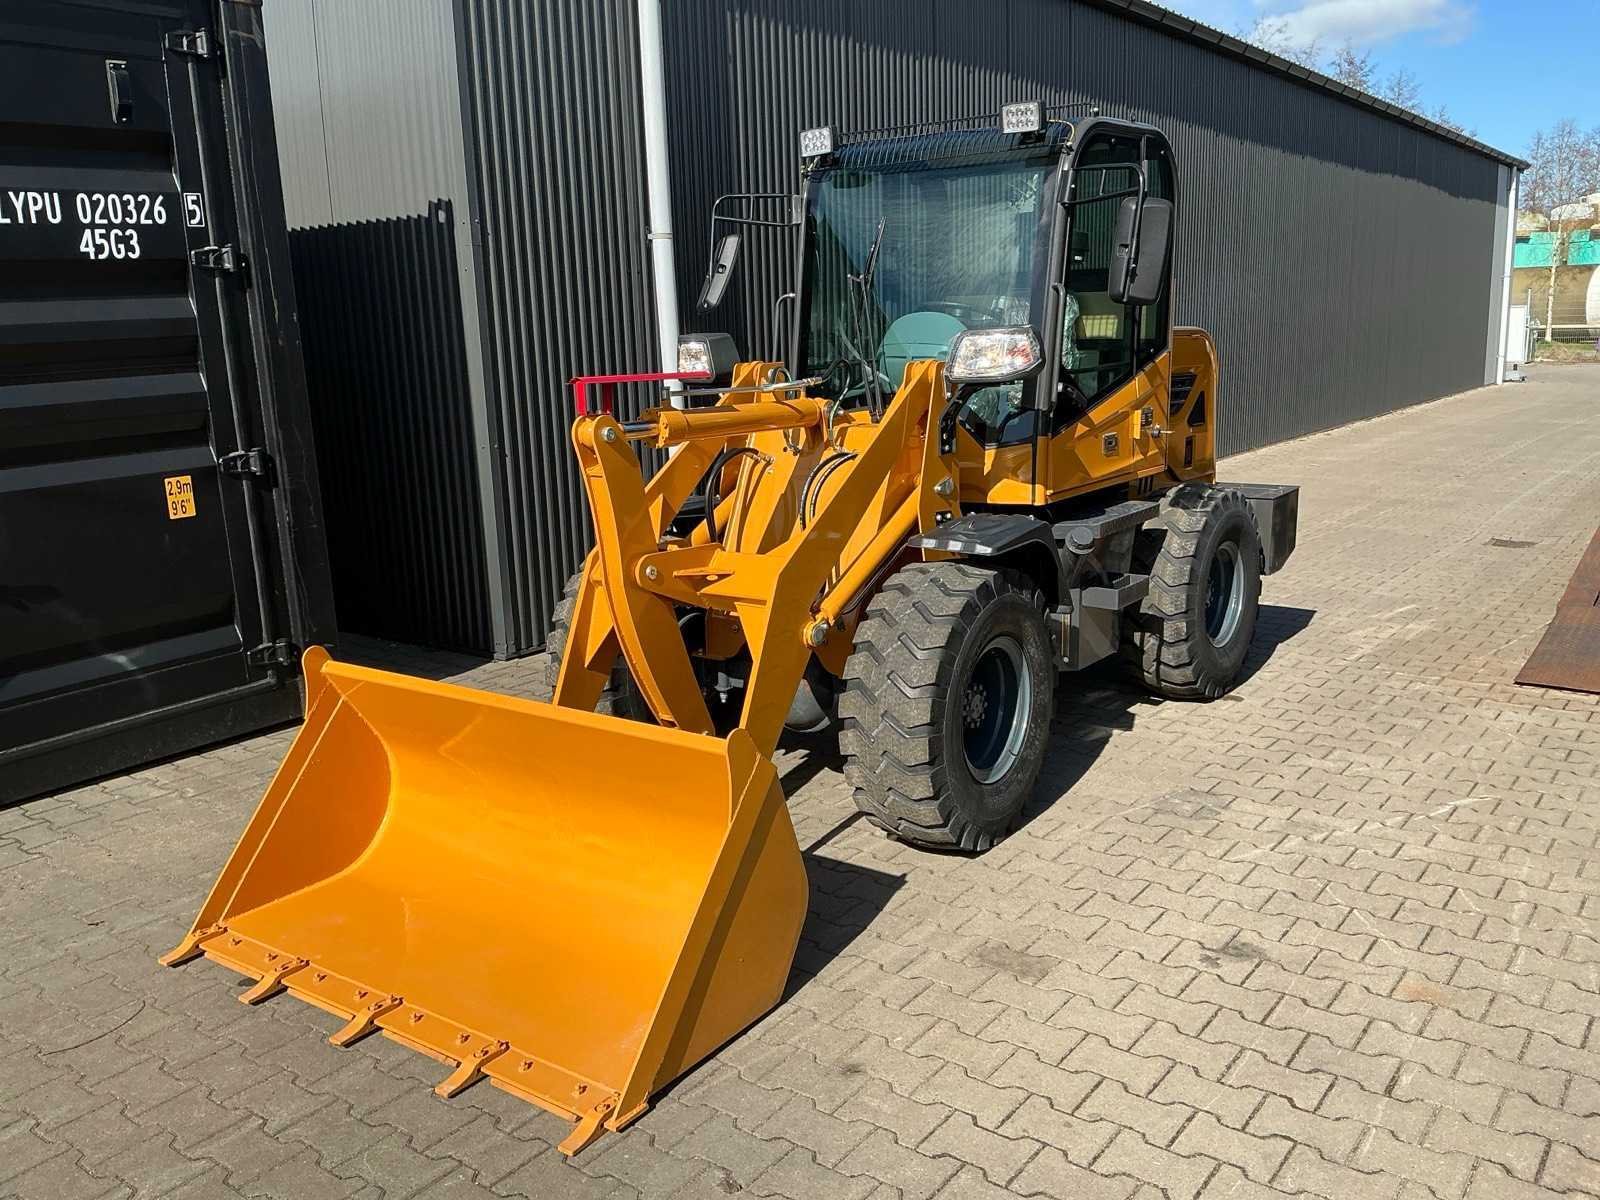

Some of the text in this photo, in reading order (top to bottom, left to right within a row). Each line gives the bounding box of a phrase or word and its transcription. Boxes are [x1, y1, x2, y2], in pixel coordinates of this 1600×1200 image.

[76, 193, 167, 224] 020326
[186, 195, 201, 225] 5
[79, 228, 141, 260] 45G3
